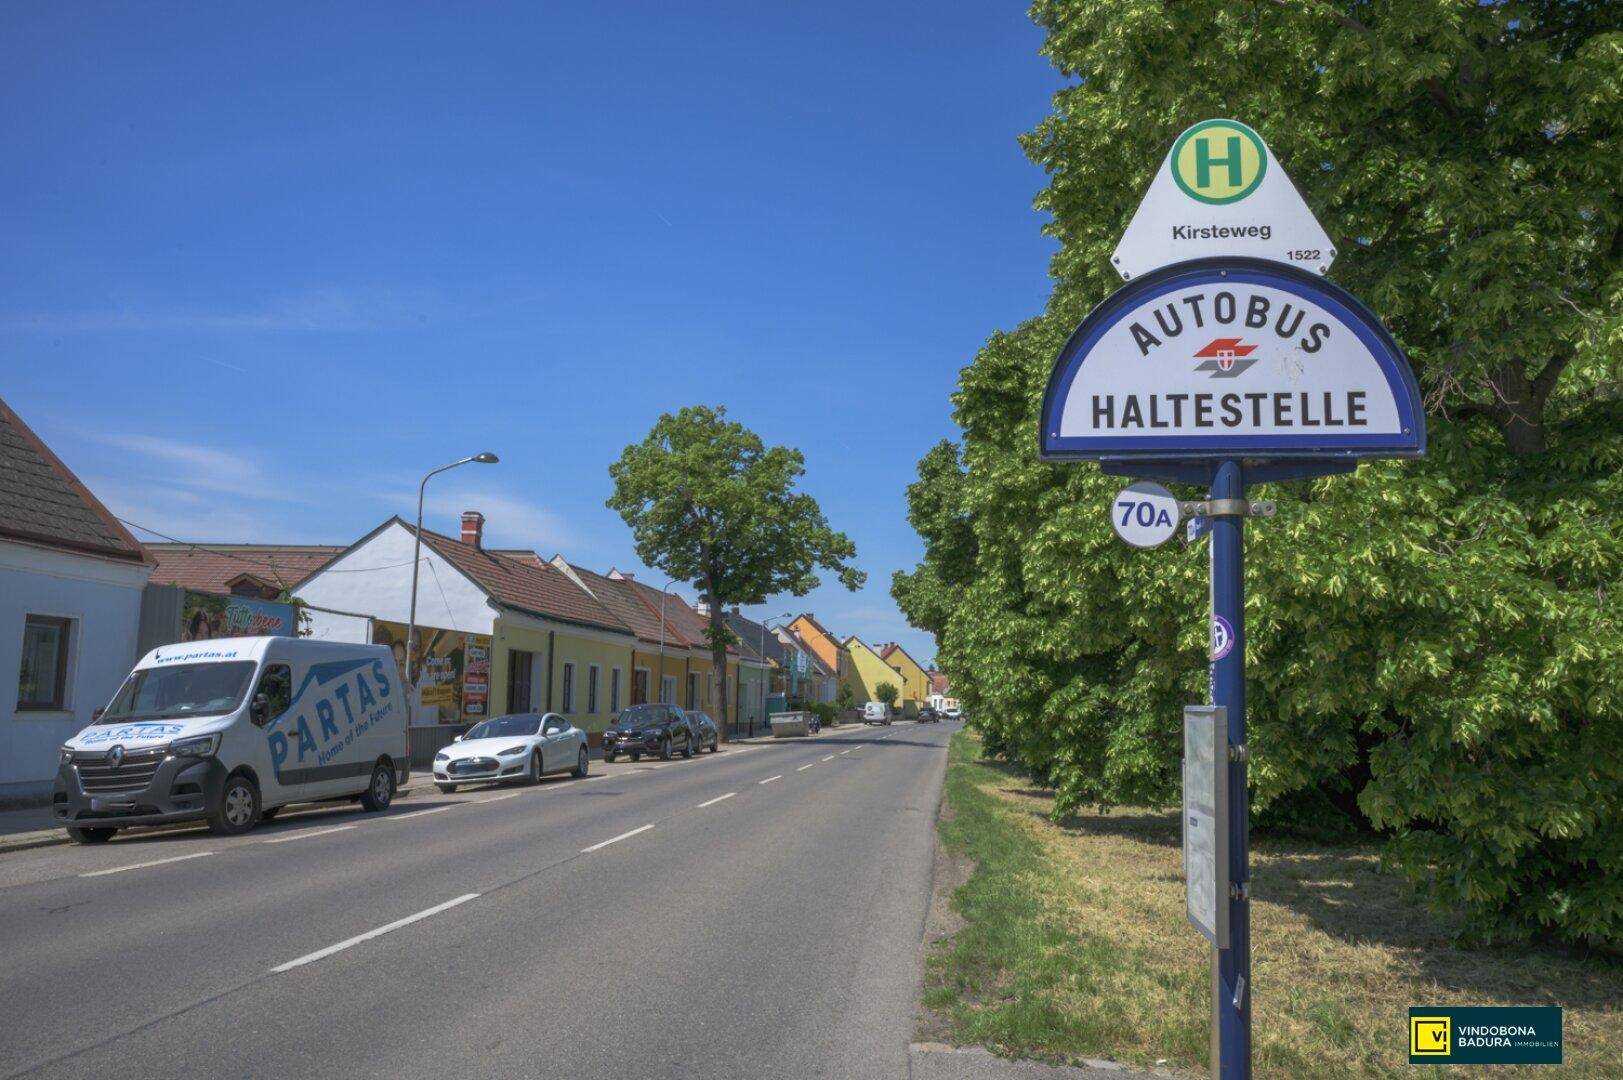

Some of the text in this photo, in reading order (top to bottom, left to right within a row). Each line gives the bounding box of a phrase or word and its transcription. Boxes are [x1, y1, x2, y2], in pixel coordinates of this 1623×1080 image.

[1196, 136, 1242, 188] H
[1172, 224, 1272, 241] Kirsteweg
[1286, 250, 1321, 261] 1522
[1128, 290, 1331, 357] AUTOBUS
[1092, 391, 1368, 429] HALTESTELLE
[1117, 501, 1173, 528] 70A
[255, 607, 284, 630] bene
[157, 651, 238, 664] www.partas.at
[268, 659, 390, 780] PARTAS
[80, 725, 183, 742] PARTAS
[318, 702, 393, 765] Home of the Future
